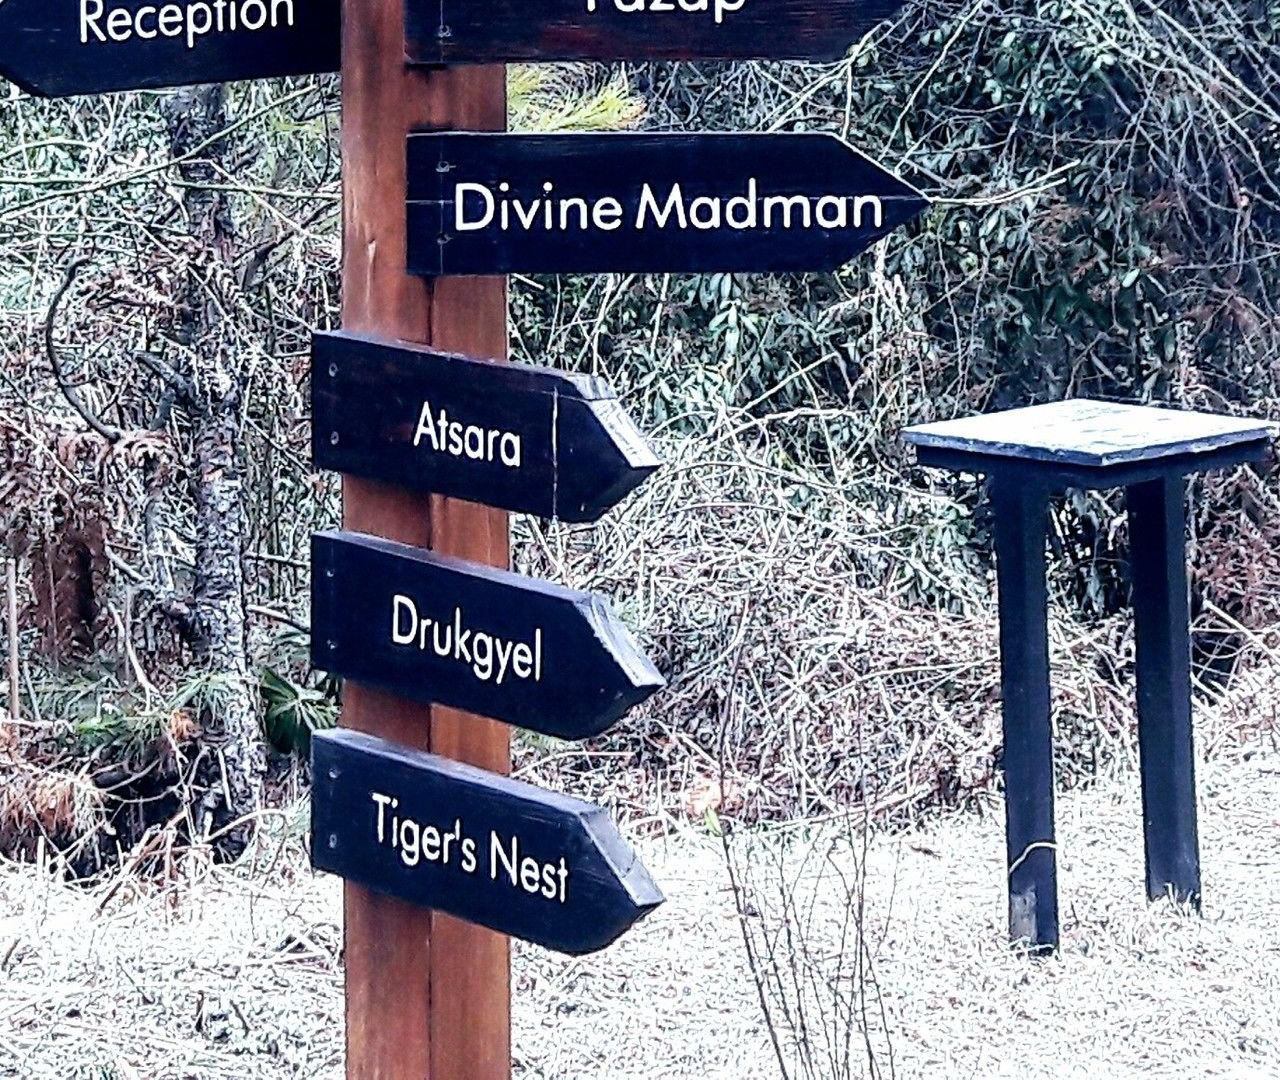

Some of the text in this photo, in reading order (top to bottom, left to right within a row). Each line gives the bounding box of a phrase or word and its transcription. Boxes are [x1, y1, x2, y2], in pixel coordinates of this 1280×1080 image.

[455, 177, 883, 231] Divine Madman
[413, 401, 522, 467] Atsara
[392, 594, 542, 685] Drukgyel
[371, 792, 569, 903] Tiger's Nest
